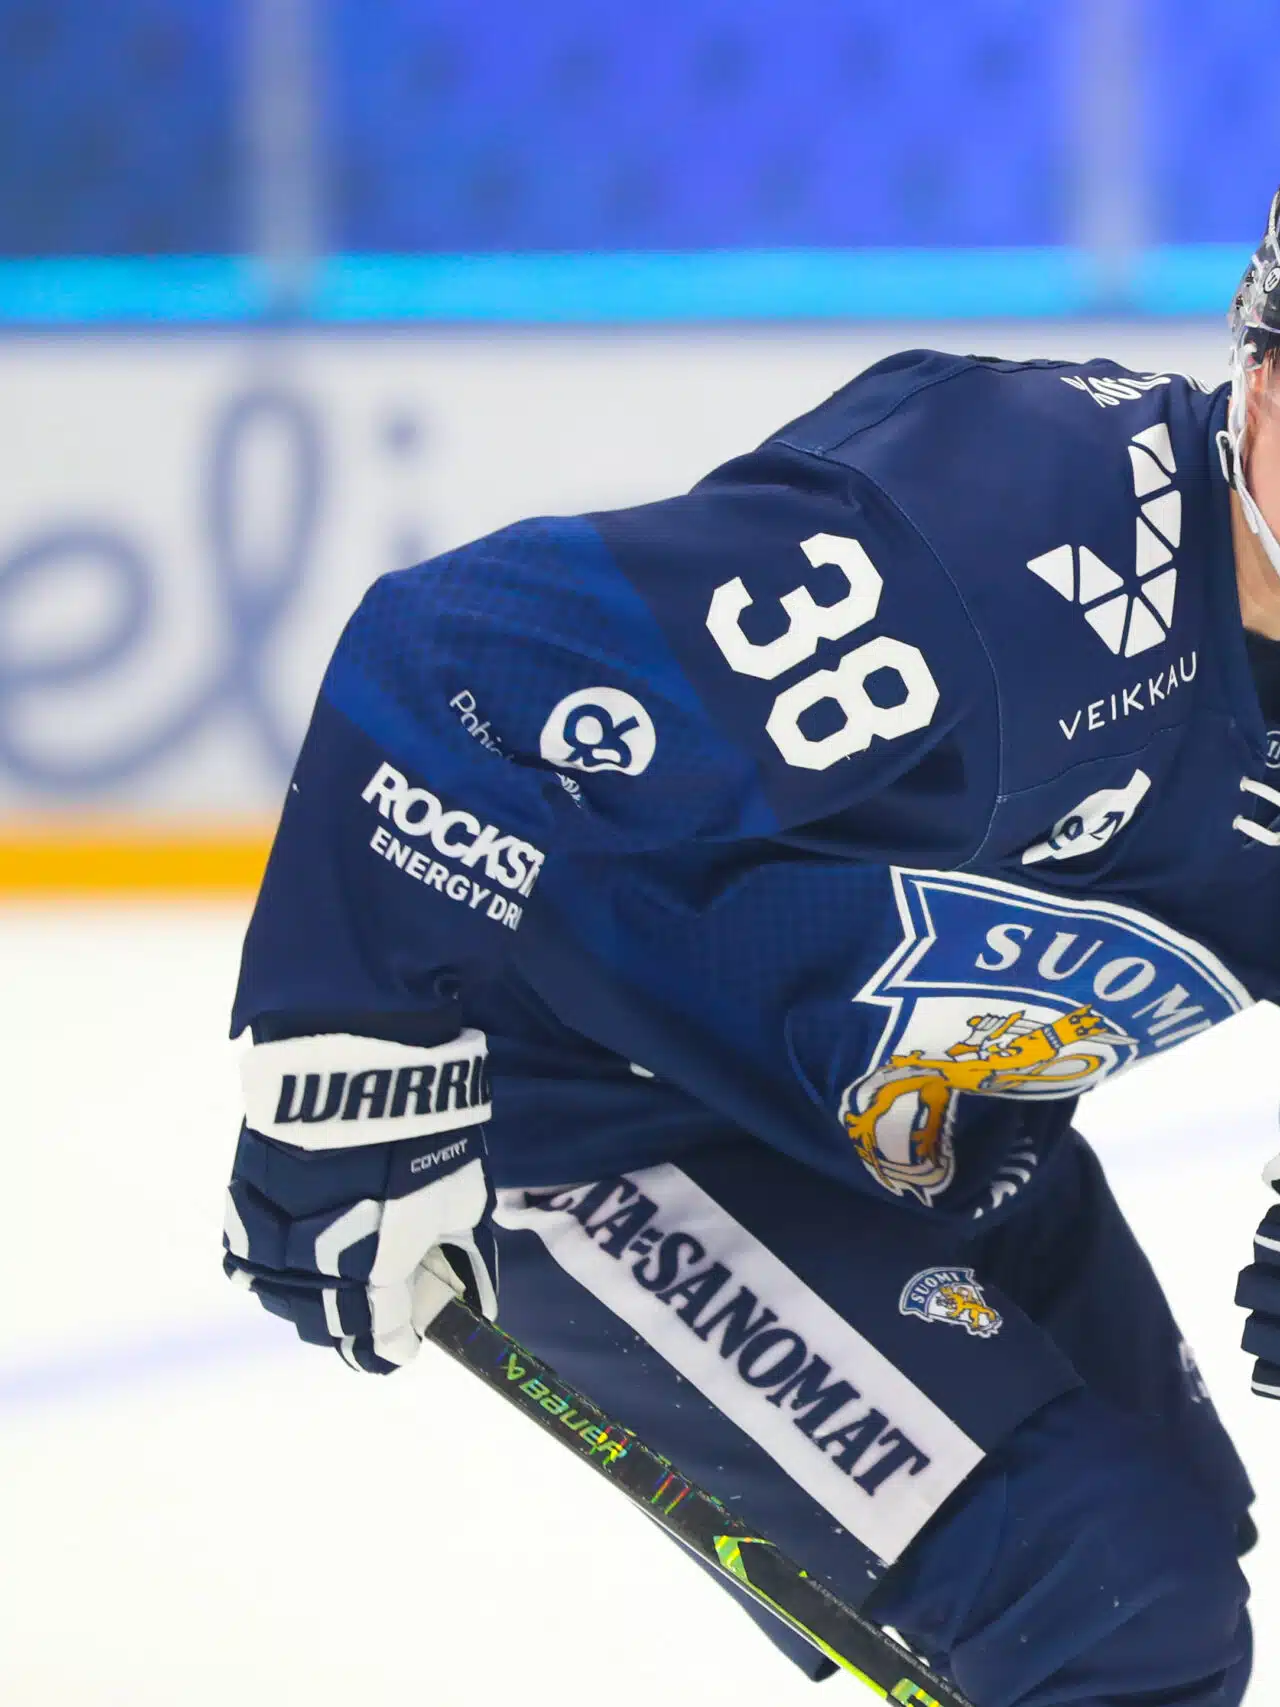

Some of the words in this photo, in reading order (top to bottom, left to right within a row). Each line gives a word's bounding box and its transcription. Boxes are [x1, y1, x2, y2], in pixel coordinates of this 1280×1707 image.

[705, 532, 940, 770] 38
[1059, 652, 1197, 740] VEIKKAU
[369, 825, 491, 909] ENERGY
[974, 923, 1212, 1048] SUOMI
[410, 1137, 468, 1174] COVERT
[911, 1272, 960, 1304] SUOMI
